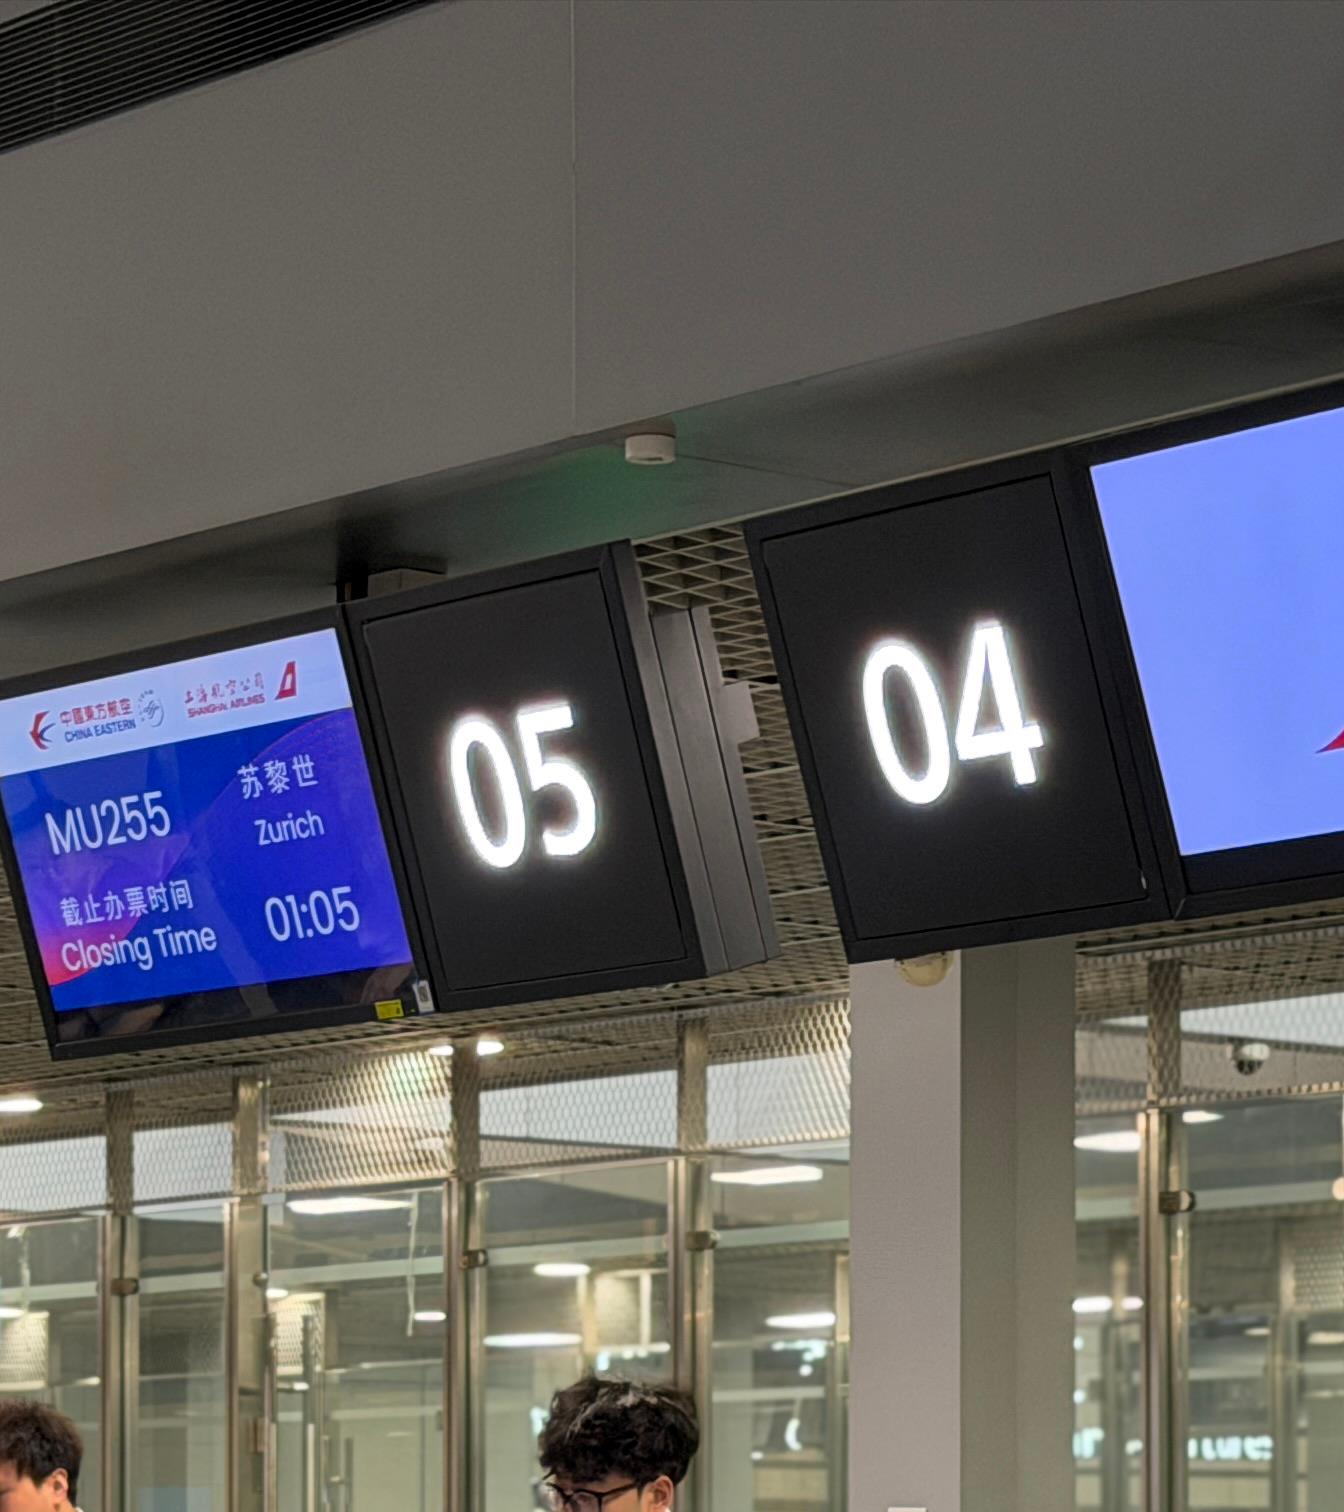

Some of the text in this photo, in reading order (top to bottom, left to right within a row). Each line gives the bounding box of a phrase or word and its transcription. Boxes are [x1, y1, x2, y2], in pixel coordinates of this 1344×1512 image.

[64, 729, 93, 743] CHINA
[94, 718, 136, 737] EASTERN
[861, 619, 1045, 806] 04
[237, 753, 316, 801] 苏黎世
[448, 700, 598, 870] 05
[44, 790, 172, 856] MU255
[255, 810, 325, 846] Zurich
[59, 879, 194, 928] 截止办票时间
[264, 885, 361, 943] 01:05
[60, 923, 217, 973] Closing Time
